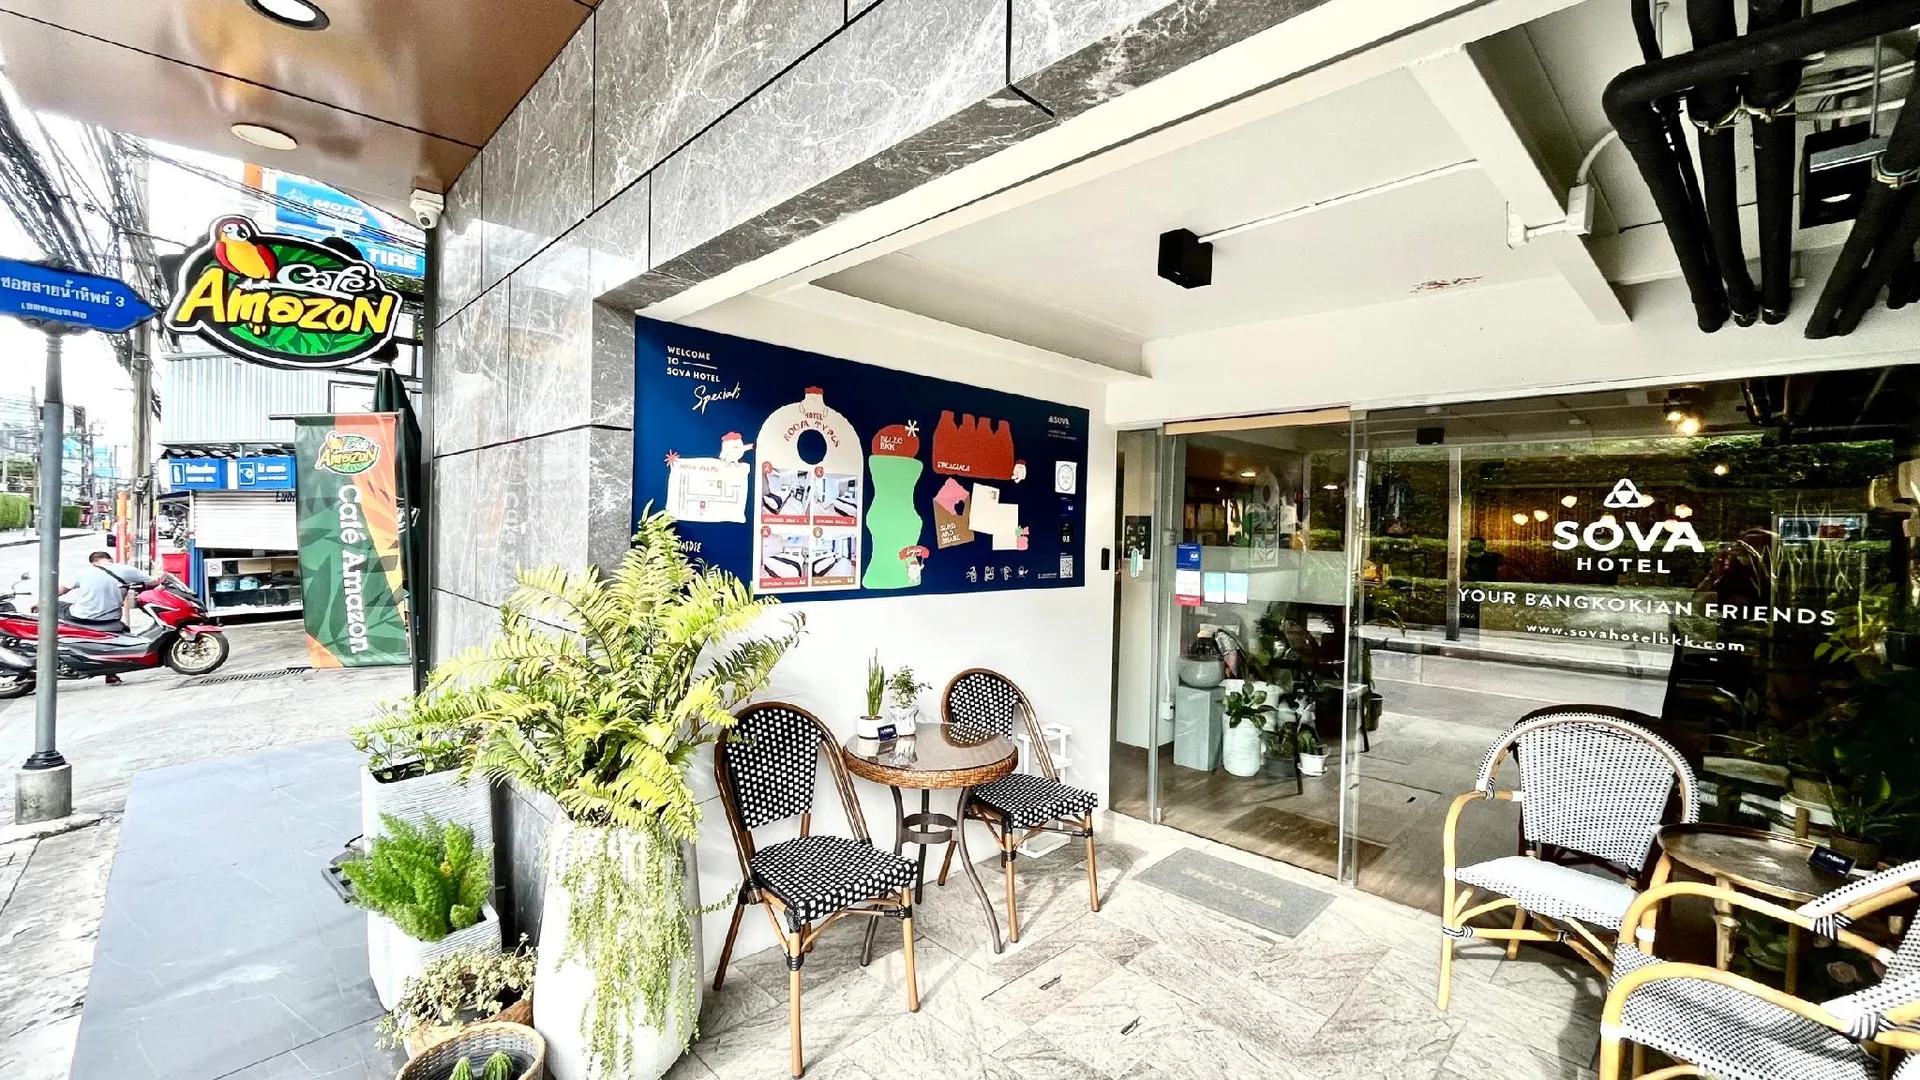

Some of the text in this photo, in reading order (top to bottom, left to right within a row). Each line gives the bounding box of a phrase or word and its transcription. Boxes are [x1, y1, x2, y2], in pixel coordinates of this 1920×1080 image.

[313, 199, 363, 216] MOTO
[367, 247, 418, 271] TIRE
[115, 296, 125, 308] 3
[667, 345, 711, 361] WELCOME
[667, 356, 679, 365] TO
[666, 367, 721, 383] SOVA HOTEL
[1552, 520, 1706, 553] SOVA
[338, 484, 369, 654] Café Amazon
[1576, 557, 1671, 574] HOTEL
[1458, 588, 1836, 626] YOUR BANGKOKIAN FRIENDS
[1526, 624, 1746, 652] www.sovahotelbkk.com
